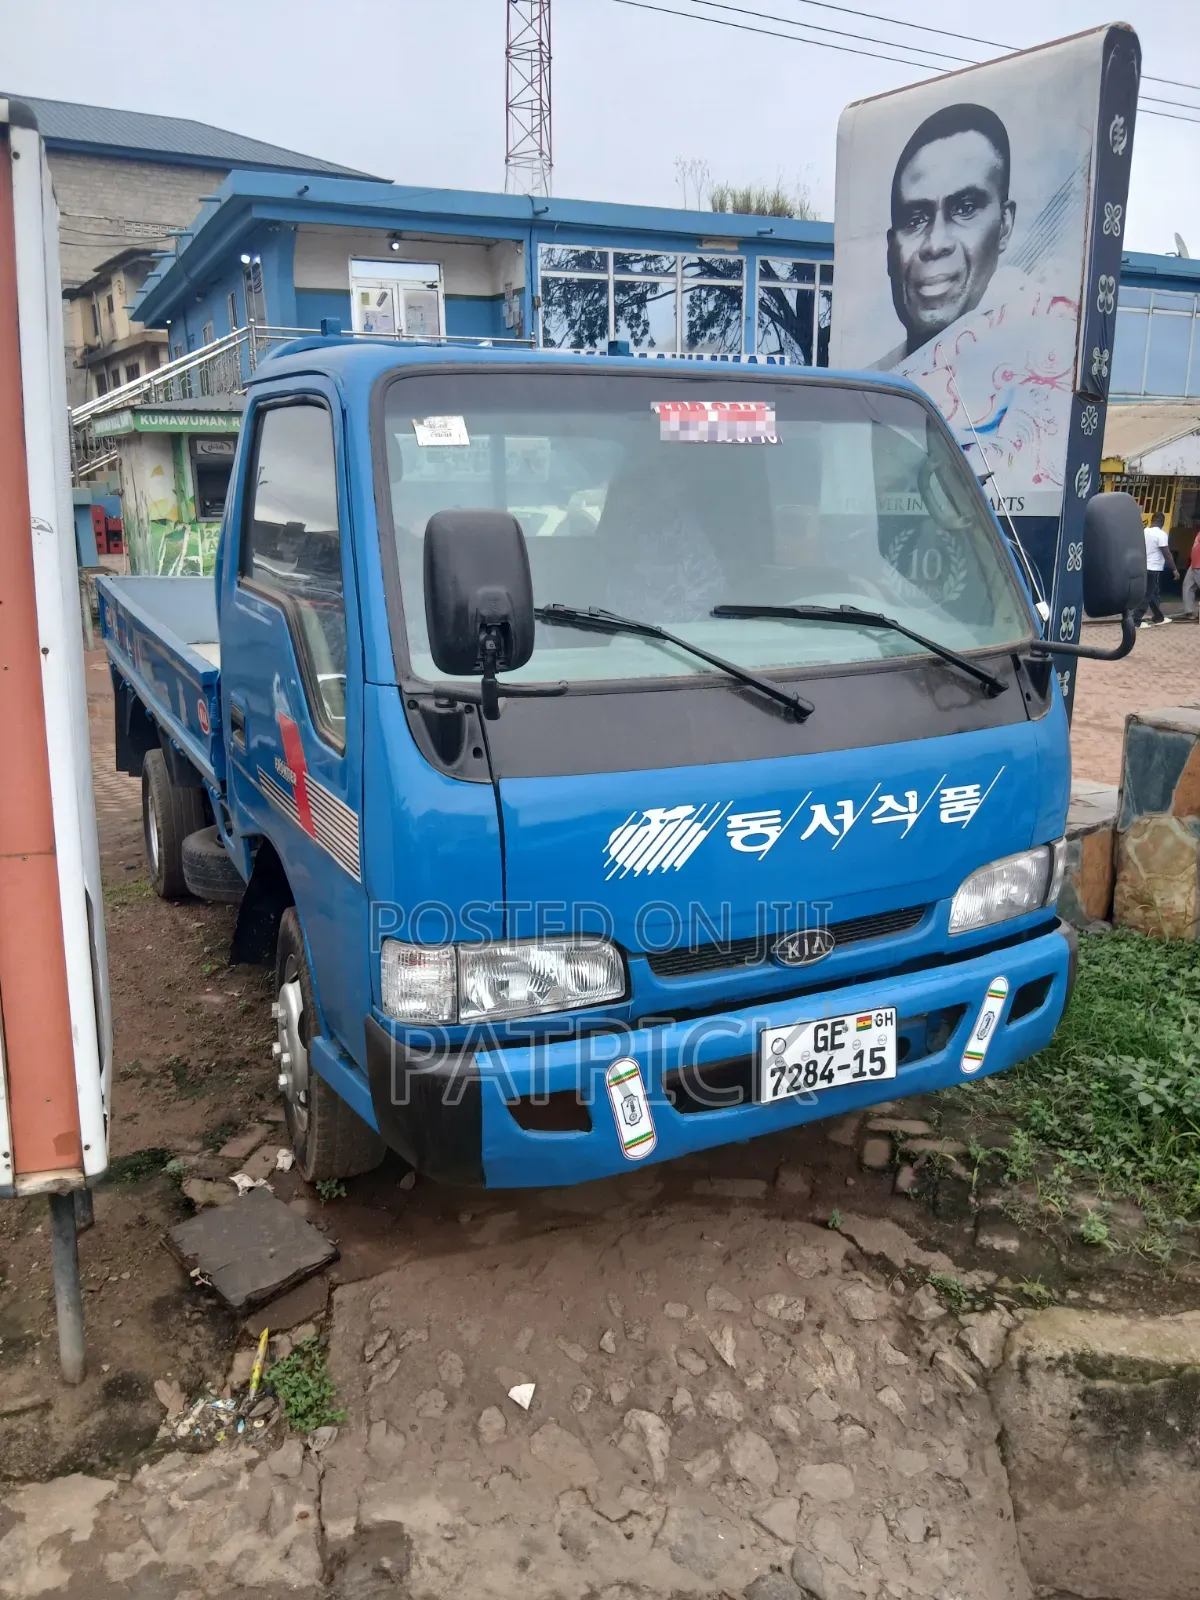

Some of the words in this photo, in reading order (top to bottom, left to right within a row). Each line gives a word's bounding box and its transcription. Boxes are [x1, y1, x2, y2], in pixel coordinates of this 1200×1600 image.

[140, 415, 227, 427] KUMAWUMAN
[907, 548, 943, 581] 10
[726, 775, 994, 858] 동서식품
[788, 936, 827, 959] KIA
[813, 1019, 846, 1054] GE
[875, 1011, 893, 1028] GH
[769, 1046, 887, 1098] 7284-15
